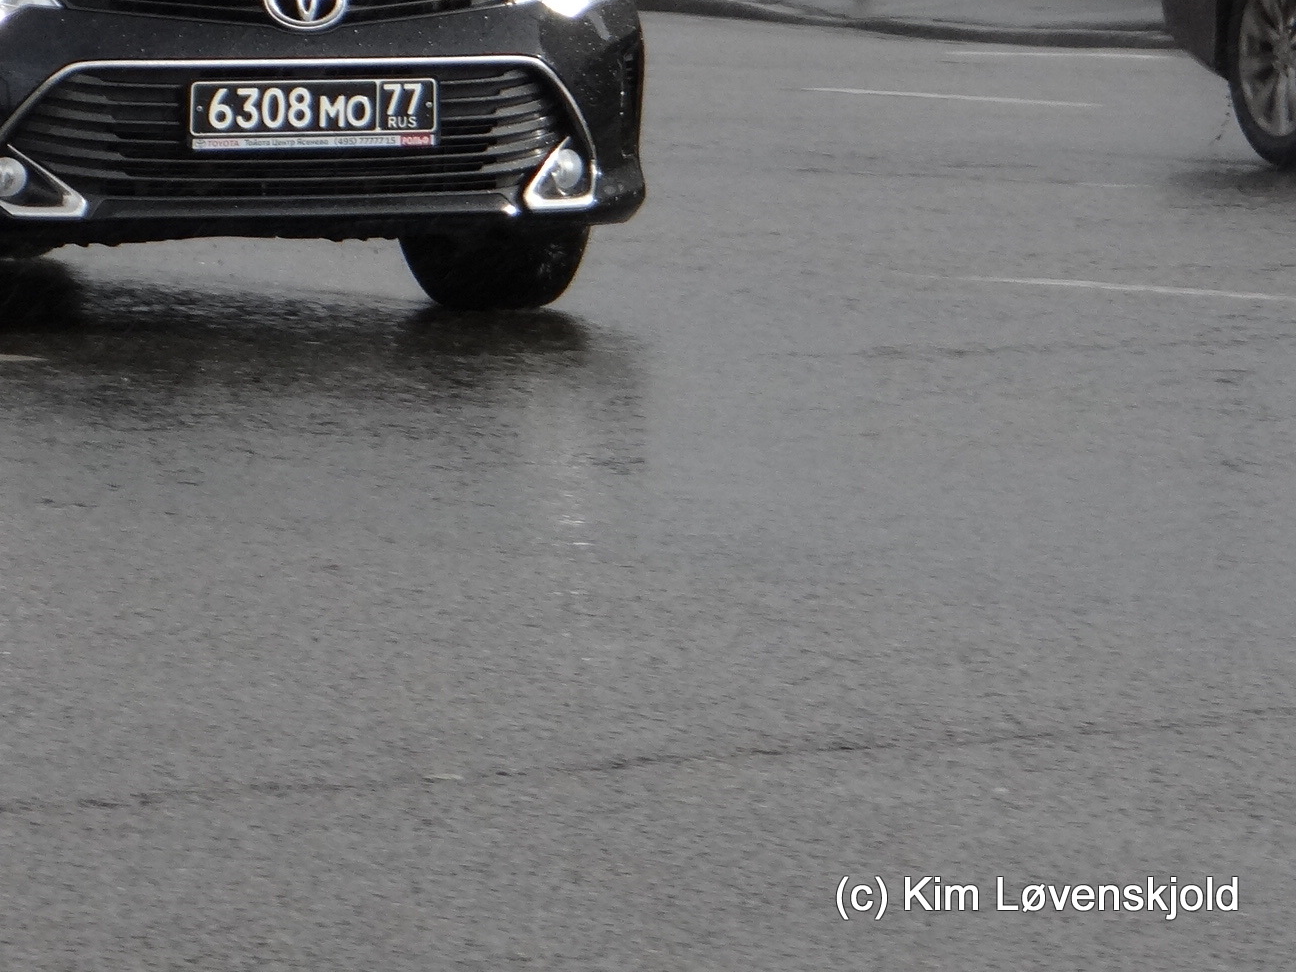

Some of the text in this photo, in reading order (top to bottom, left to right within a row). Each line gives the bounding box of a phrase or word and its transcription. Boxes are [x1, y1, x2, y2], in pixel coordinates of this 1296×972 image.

[383, 83, 423, 116] 77
[387, 116, 417, 129] RUS
[207, 140, 240, 148] TOYOTA
